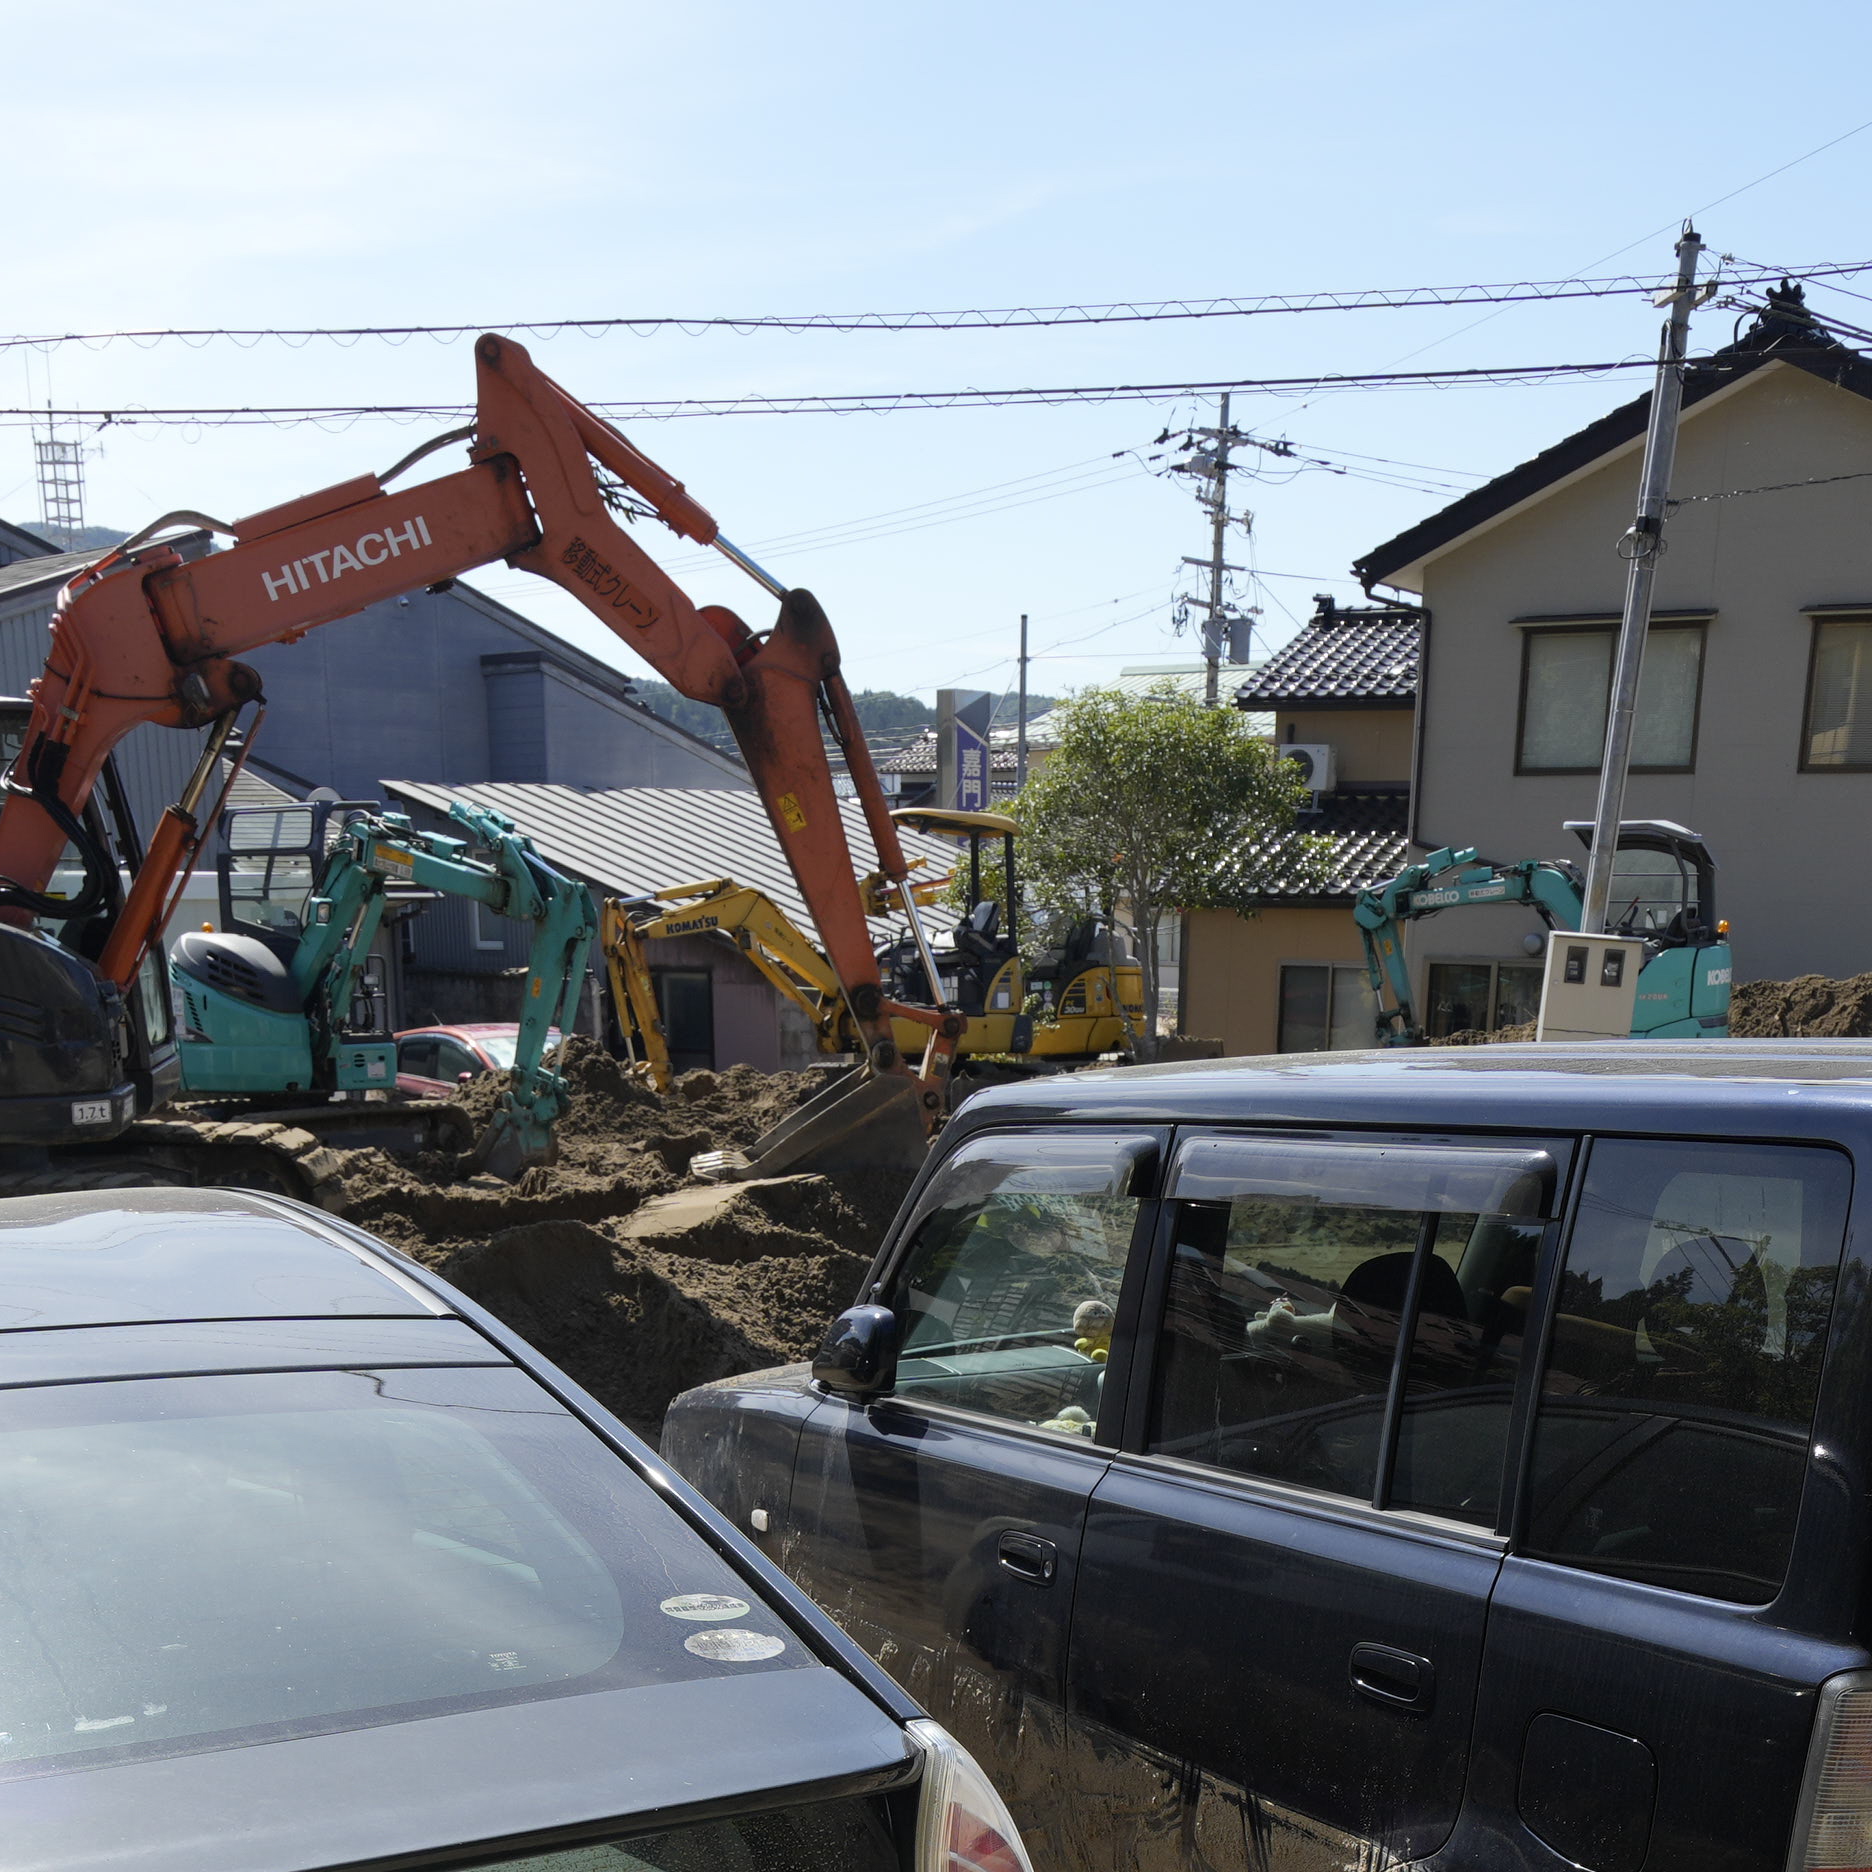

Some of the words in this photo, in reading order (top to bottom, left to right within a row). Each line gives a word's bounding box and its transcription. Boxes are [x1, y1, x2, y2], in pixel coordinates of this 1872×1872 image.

[261, 516, 432, 601] HITACHI
[562, 536, 659, 629] 移動式クレーン
[1413, 891, 1460, 906] KOBELCO
[665, 915, 718, 935] KOMATSU
